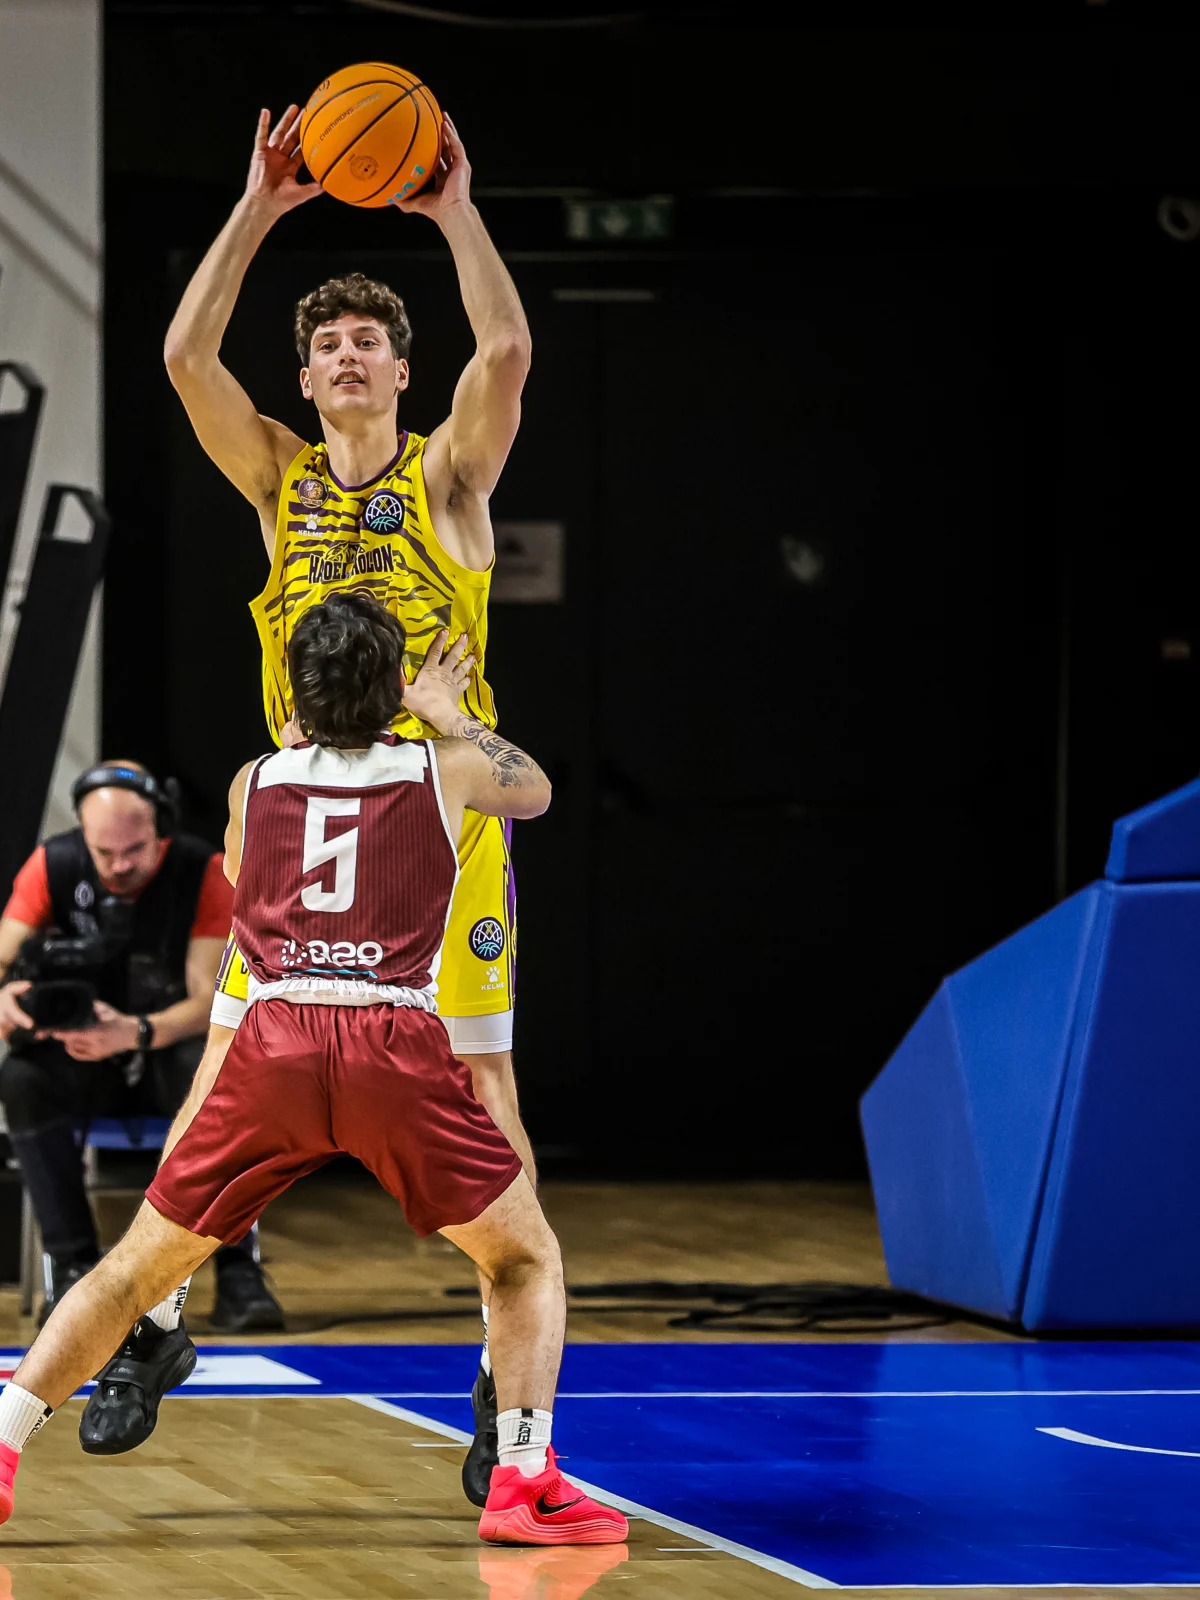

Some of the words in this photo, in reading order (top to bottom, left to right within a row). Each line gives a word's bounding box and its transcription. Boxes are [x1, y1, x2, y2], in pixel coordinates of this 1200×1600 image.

[297, 530, 324, 538] KELME
[301, 797, 361, 913] 5
[481, 982, 505, 991] KELME
